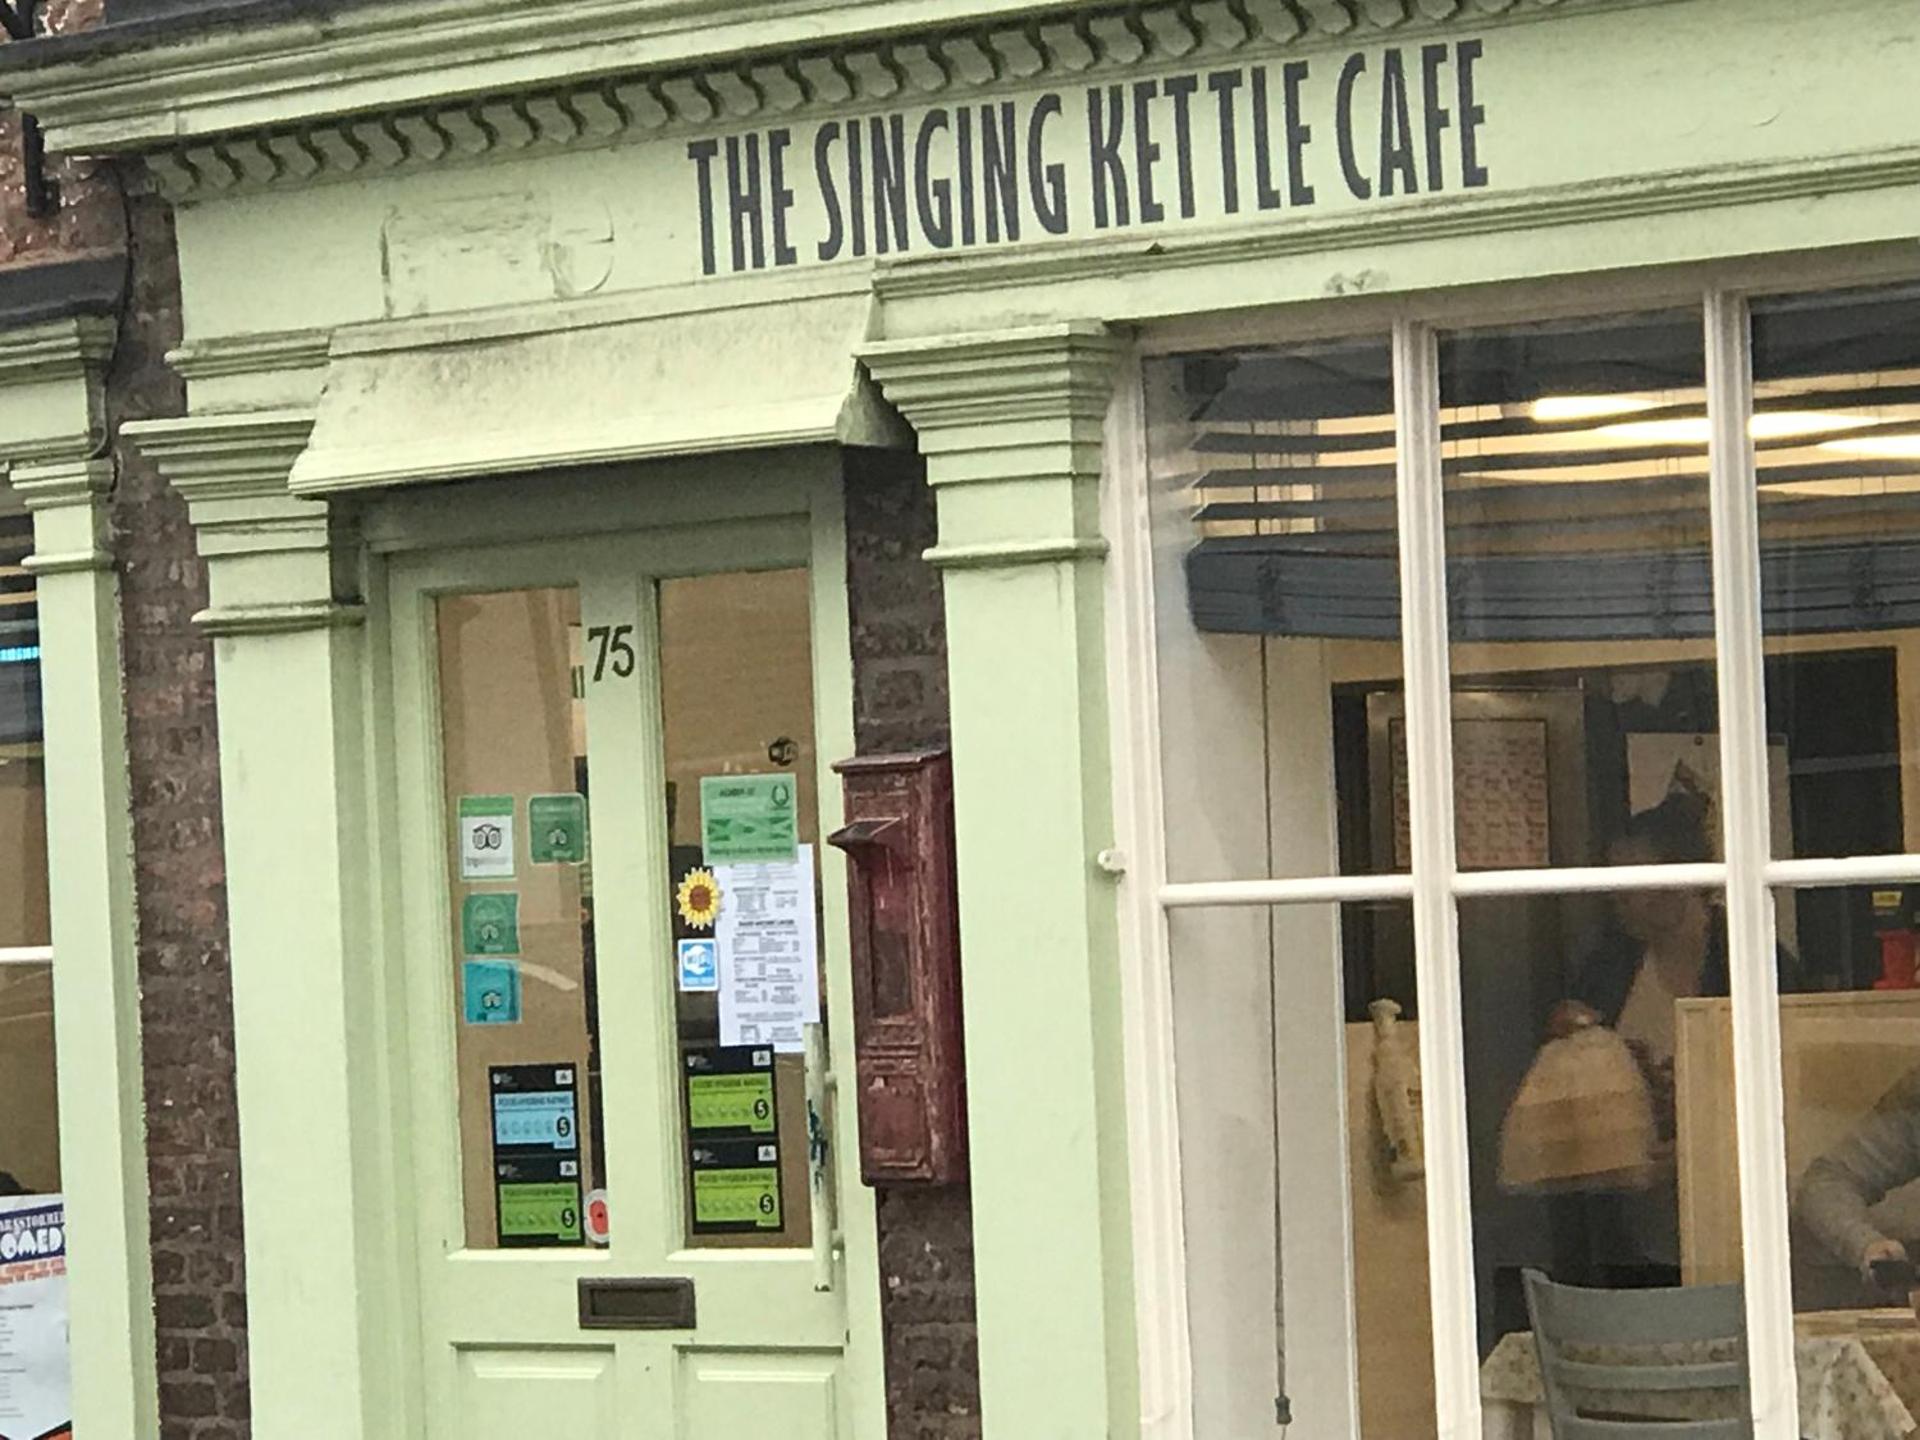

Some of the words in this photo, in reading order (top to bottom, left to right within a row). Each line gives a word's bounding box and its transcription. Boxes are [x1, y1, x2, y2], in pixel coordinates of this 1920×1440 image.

[687, 128, 798, 276] THE
[814, 94, 1069, 262] SINGING
[1086, 60, 1316, 229] KETTLE
[1335, 38, 1489, 201] CAFE
[587, 624, 635, 682] 75
